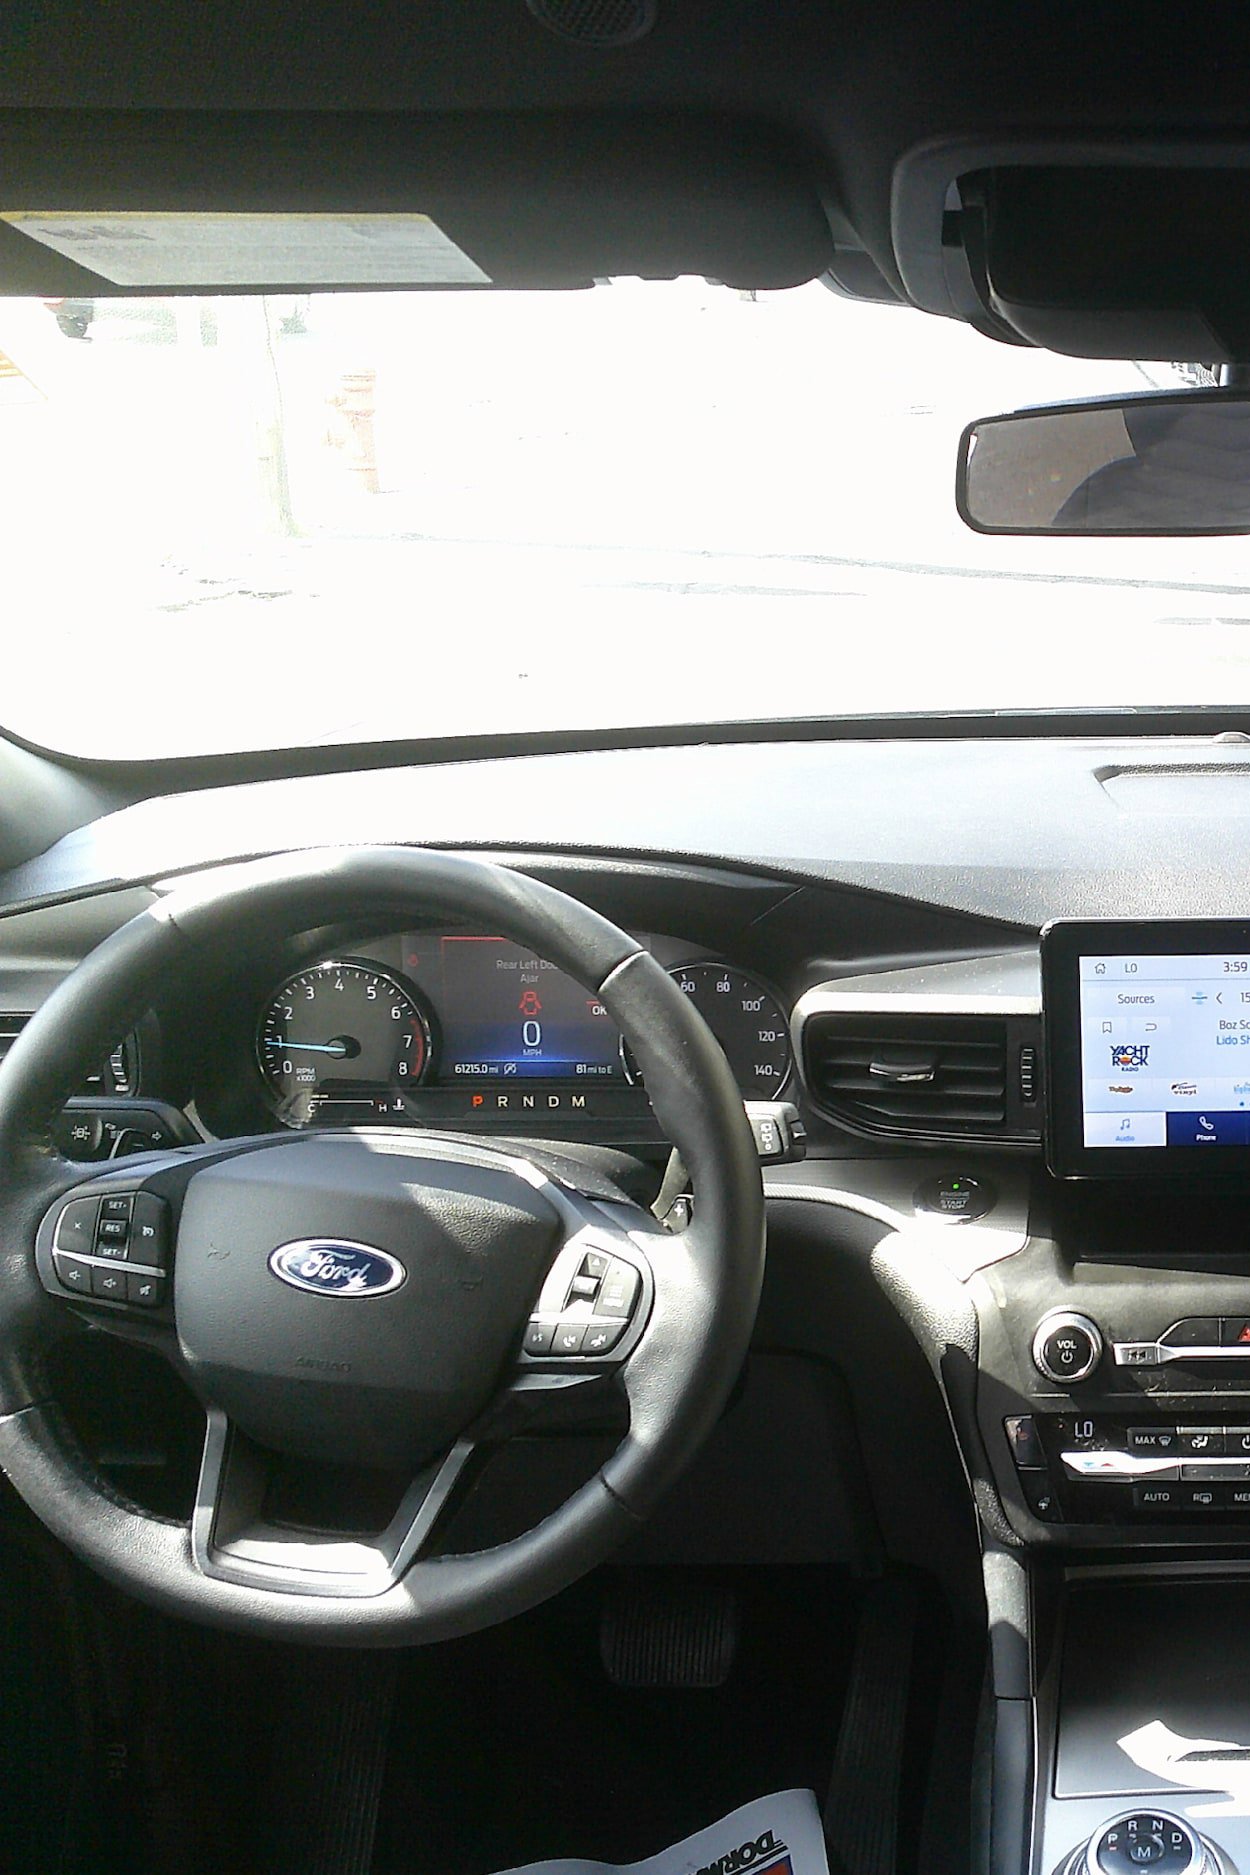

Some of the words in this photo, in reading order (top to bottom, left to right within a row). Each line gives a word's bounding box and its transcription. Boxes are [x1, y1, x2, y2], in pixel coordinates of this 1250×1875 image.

[496, 959, 517, 970] Rear
[519, 959, 538, 970] Left
[1124, 962, 1138, 974] LO
[1223, 961, 1248, 973] 3:59
[520, 973, 539, 984] Ajar
[334, 978, 344, 992] 4
[680, 981, 695, 992] 60
[716, 981, 731, 993] 80
[306, 986, 315, 1000] 3
[367, 985, 376, 1000] 5
[1117, 993, 1156, 1005] Sources
[592, 1005, 608, 1016] OK
[742, 1000, 761, 1011] 100
[284, 1006, 293, 1020] 2
[391, 1005, 401, 1019] 6
[1219, 1019, 1237, 1030] Boz
[522, 1020, 541, 1047] 0
[758, 1030, 776, 1042] 120
[402, 1034, 412, 1048] 7
[1216, 1035, 1238, 1045] Lido
[522, 1048, 543, 1056] MPH
[1110, 1045, 1150, 1056] YACHT
[1112, 1056, 1149, 1066] ROCK
[282, 1060, 292, 1074] 0
[296, 1067, 315, 1075] RPM
[398, 1061, 408, 1076] 8
[454, 1064, 488, 1074] 61215.0
[488, 1065, 499, 1074] mi
[575, 1064, 587, 1074] 81
[587, 1065, 597, 1074] mi
[598, 1065, 606, 1074] to
[606, 1064, 613, 1074] E
[754, 1064, 773, 1076] 140
[472, 1095, 483, 1108] P
[497, 1095, 509, 1108] R
[522, 1095, 535, 1108] N
[548, 1095, 560, 1108] D
[571, 1095, 586, 1108] M
[307, 1104, 316, 1113] C
[378, 1104, 388, 1113] H
[1196, 1134, 1217, 1142] Phone
[105, 1224, 121, 1233] RES
[300, 1249, 372, 1287] Ford
[1056, 1339, 1077, 1349] VOL
[1074, 1420, 1094, 1438] LO
[1134, 1435, 1156, 1445] MAX
[1143, 1492, 1170, 1502] AUTO
[1128, 1820, 1138, 1831] R
[1152, 1820, 1164, 1831] N
[1107, 1833, 1119, 1844] P
[1171, 1832, 1183, 1844] D
[1137, 1846, 1151, 1857] M
